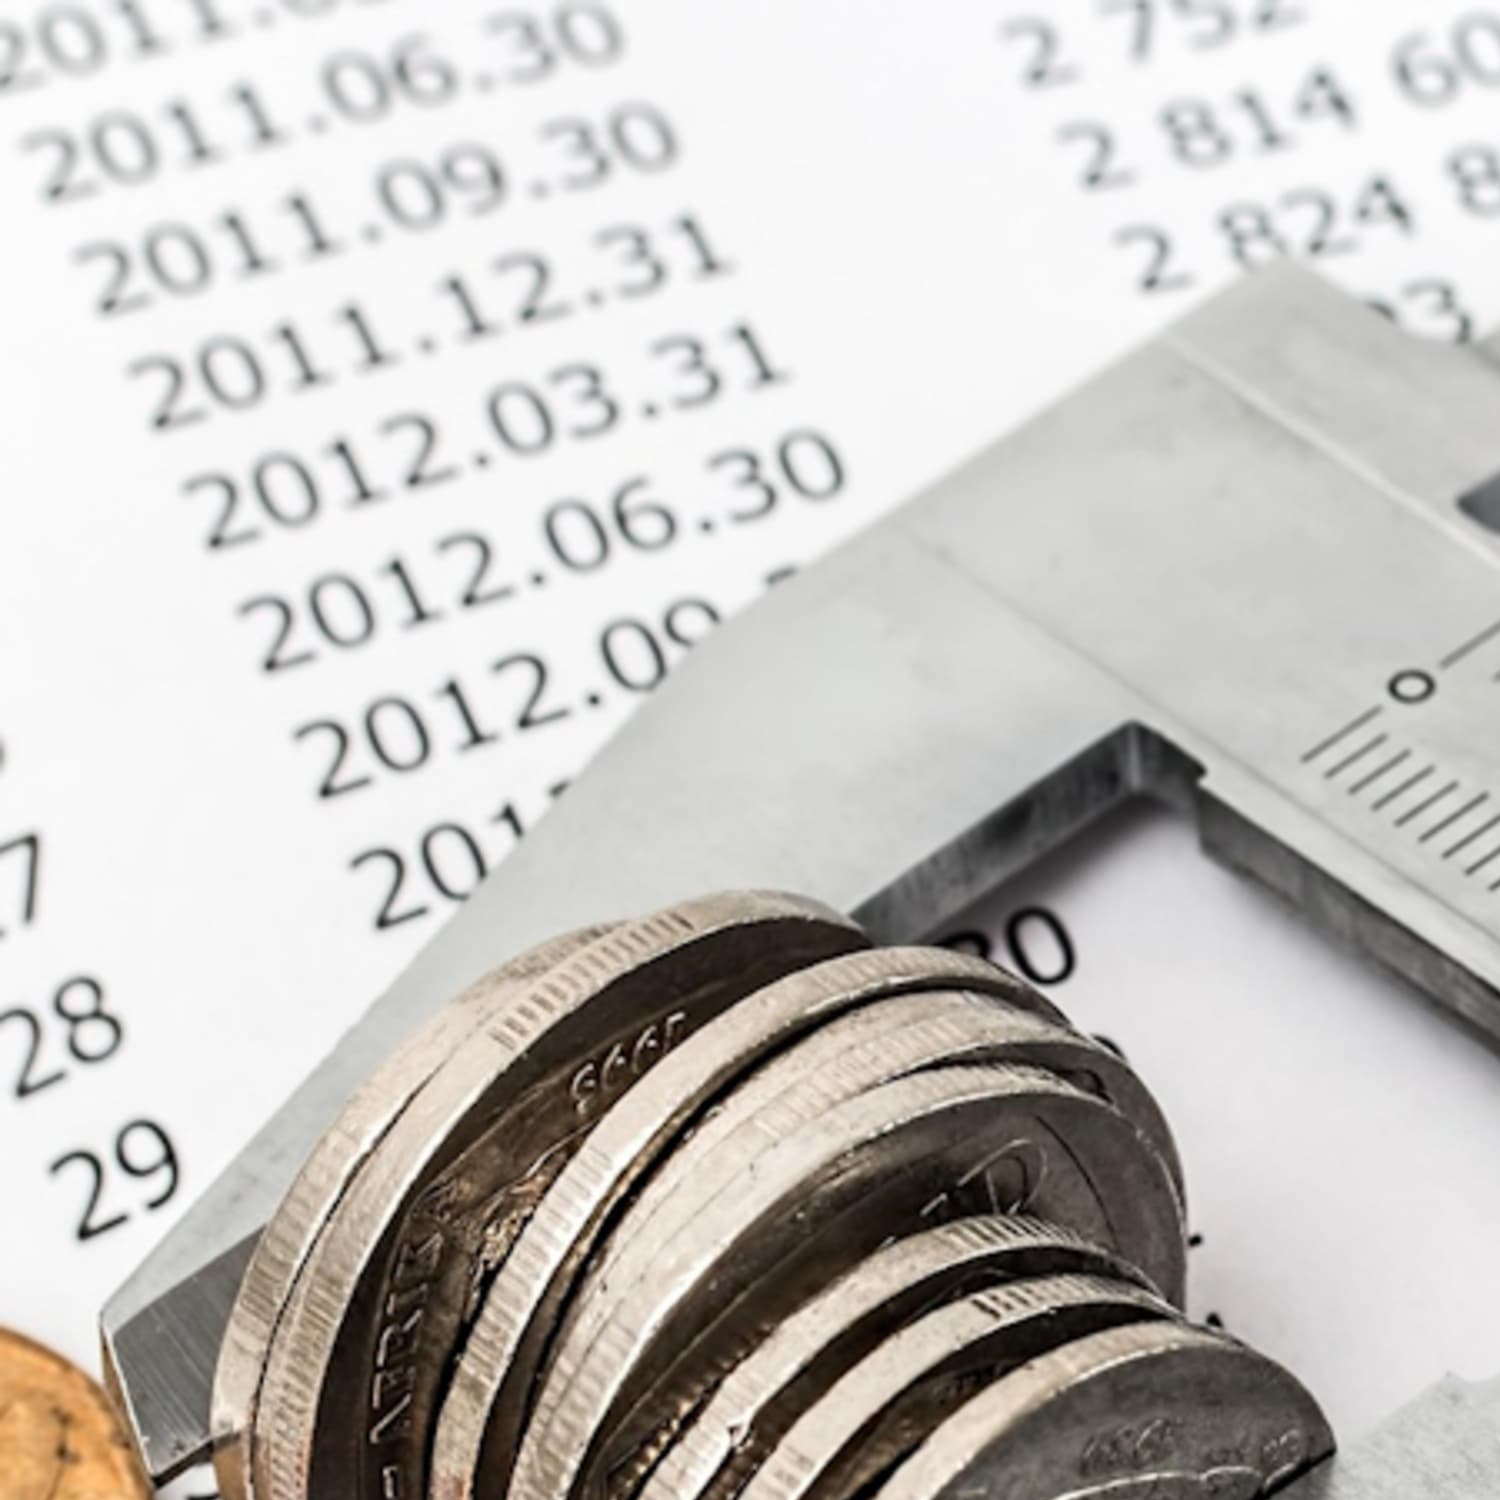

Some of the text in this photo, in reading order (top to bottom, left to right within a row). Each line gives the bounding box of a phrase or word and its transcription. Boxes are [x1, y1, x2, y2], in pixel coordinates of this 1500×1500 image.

[18, 2, 625, 203] 2011.06.30
[997, 14, 1080, 90] 2
[1055, 118, 1137, 192] 2
[1155, 62, 1358, 168] 814
[72, 102, 682, 318] 2011.09.30
[1112, 223, 1195, 297] 2
[126, 212, 734, 432] 2011.12.31
[180, 320, 790, 552] 2012.03.31
[235, 429, 845, 673] 2012.06.30
[1387, 668, 1437, 705] 0
[0, 974, 123, 1099] 28
[48, 1117, 181, 1243] 29
